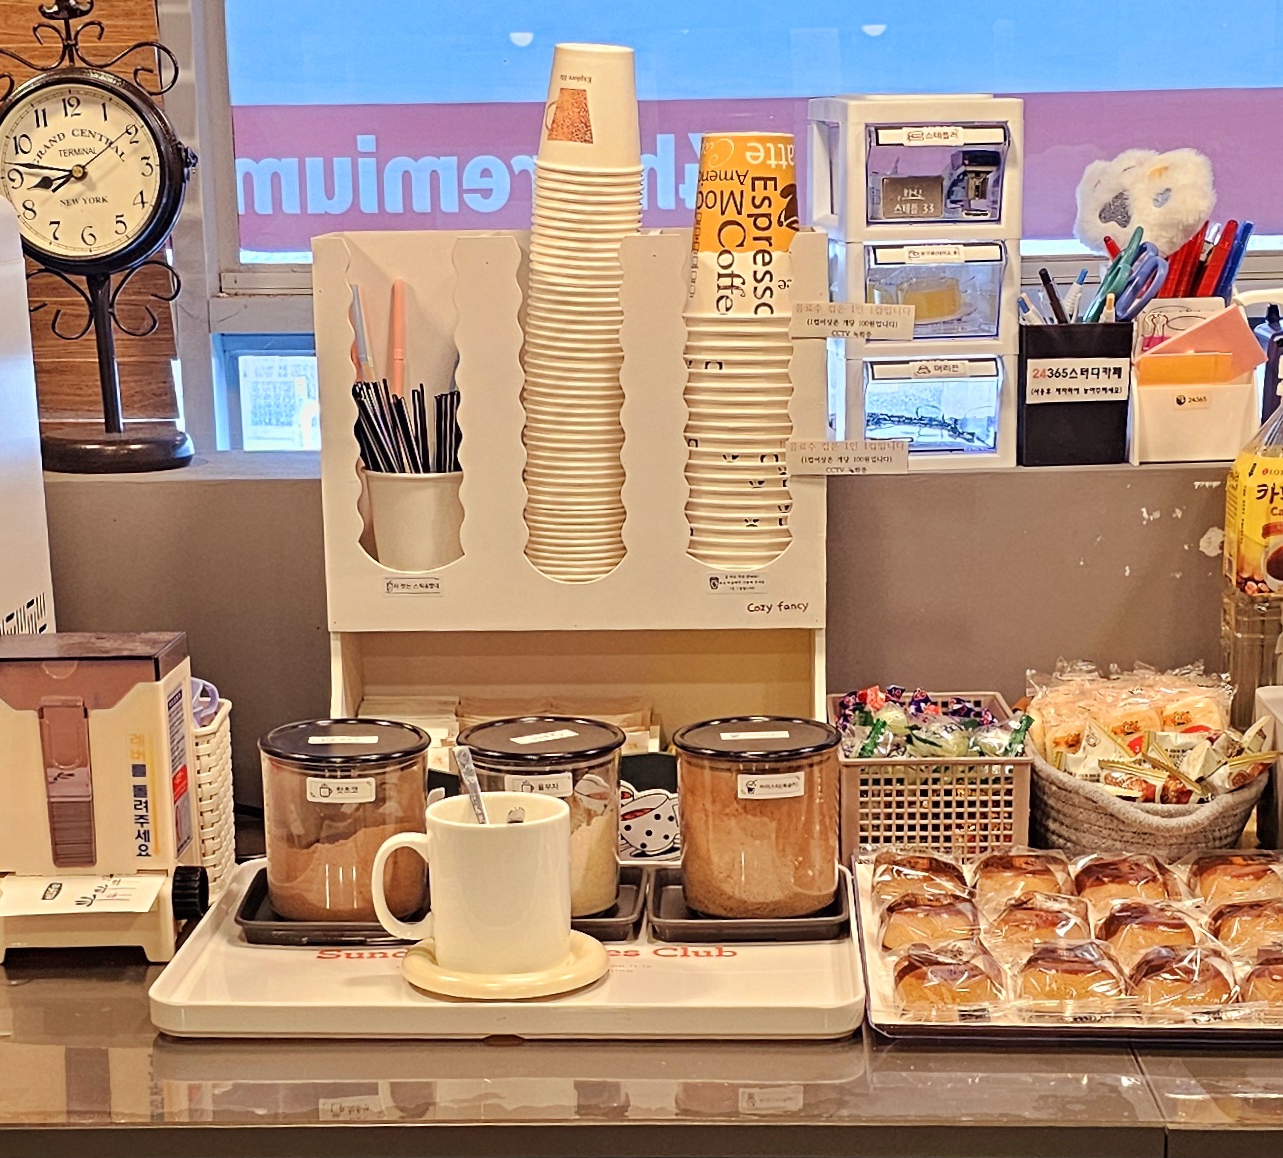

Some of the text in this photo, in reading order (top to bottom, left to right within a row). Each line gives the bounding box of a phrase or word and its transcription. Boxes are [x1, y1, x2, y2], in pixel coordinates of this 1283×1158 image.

[62, 96, 82, 118] 12
[101, 102, 108, 122] 1
[34, 108, 48, 128] 11
[13, 133, 33, 155] 10
[71, 128, 126, 162] CENTRAL
[125, 124, 139, 145] 2
[58, 147, 98, 158] TERMINAL
[141, 155, 154, 177] 3
[7, 168, 24, 189] 9
[22, 199, 37, 220] 8
[82, 196, 109, 205] YORK
[132, 190, 149, 210] 4
[922, 204, 934, 214] 33
[49, 220, 61, 241] 7
[114, 214, 128, 235] 5
[81, 225, 97, 246] 6
[1032, 366, 1123, 380] 24365스터디카페
[747, 601, 809, 614] Cozy fancy
[652, 945, 738, 958] Club
